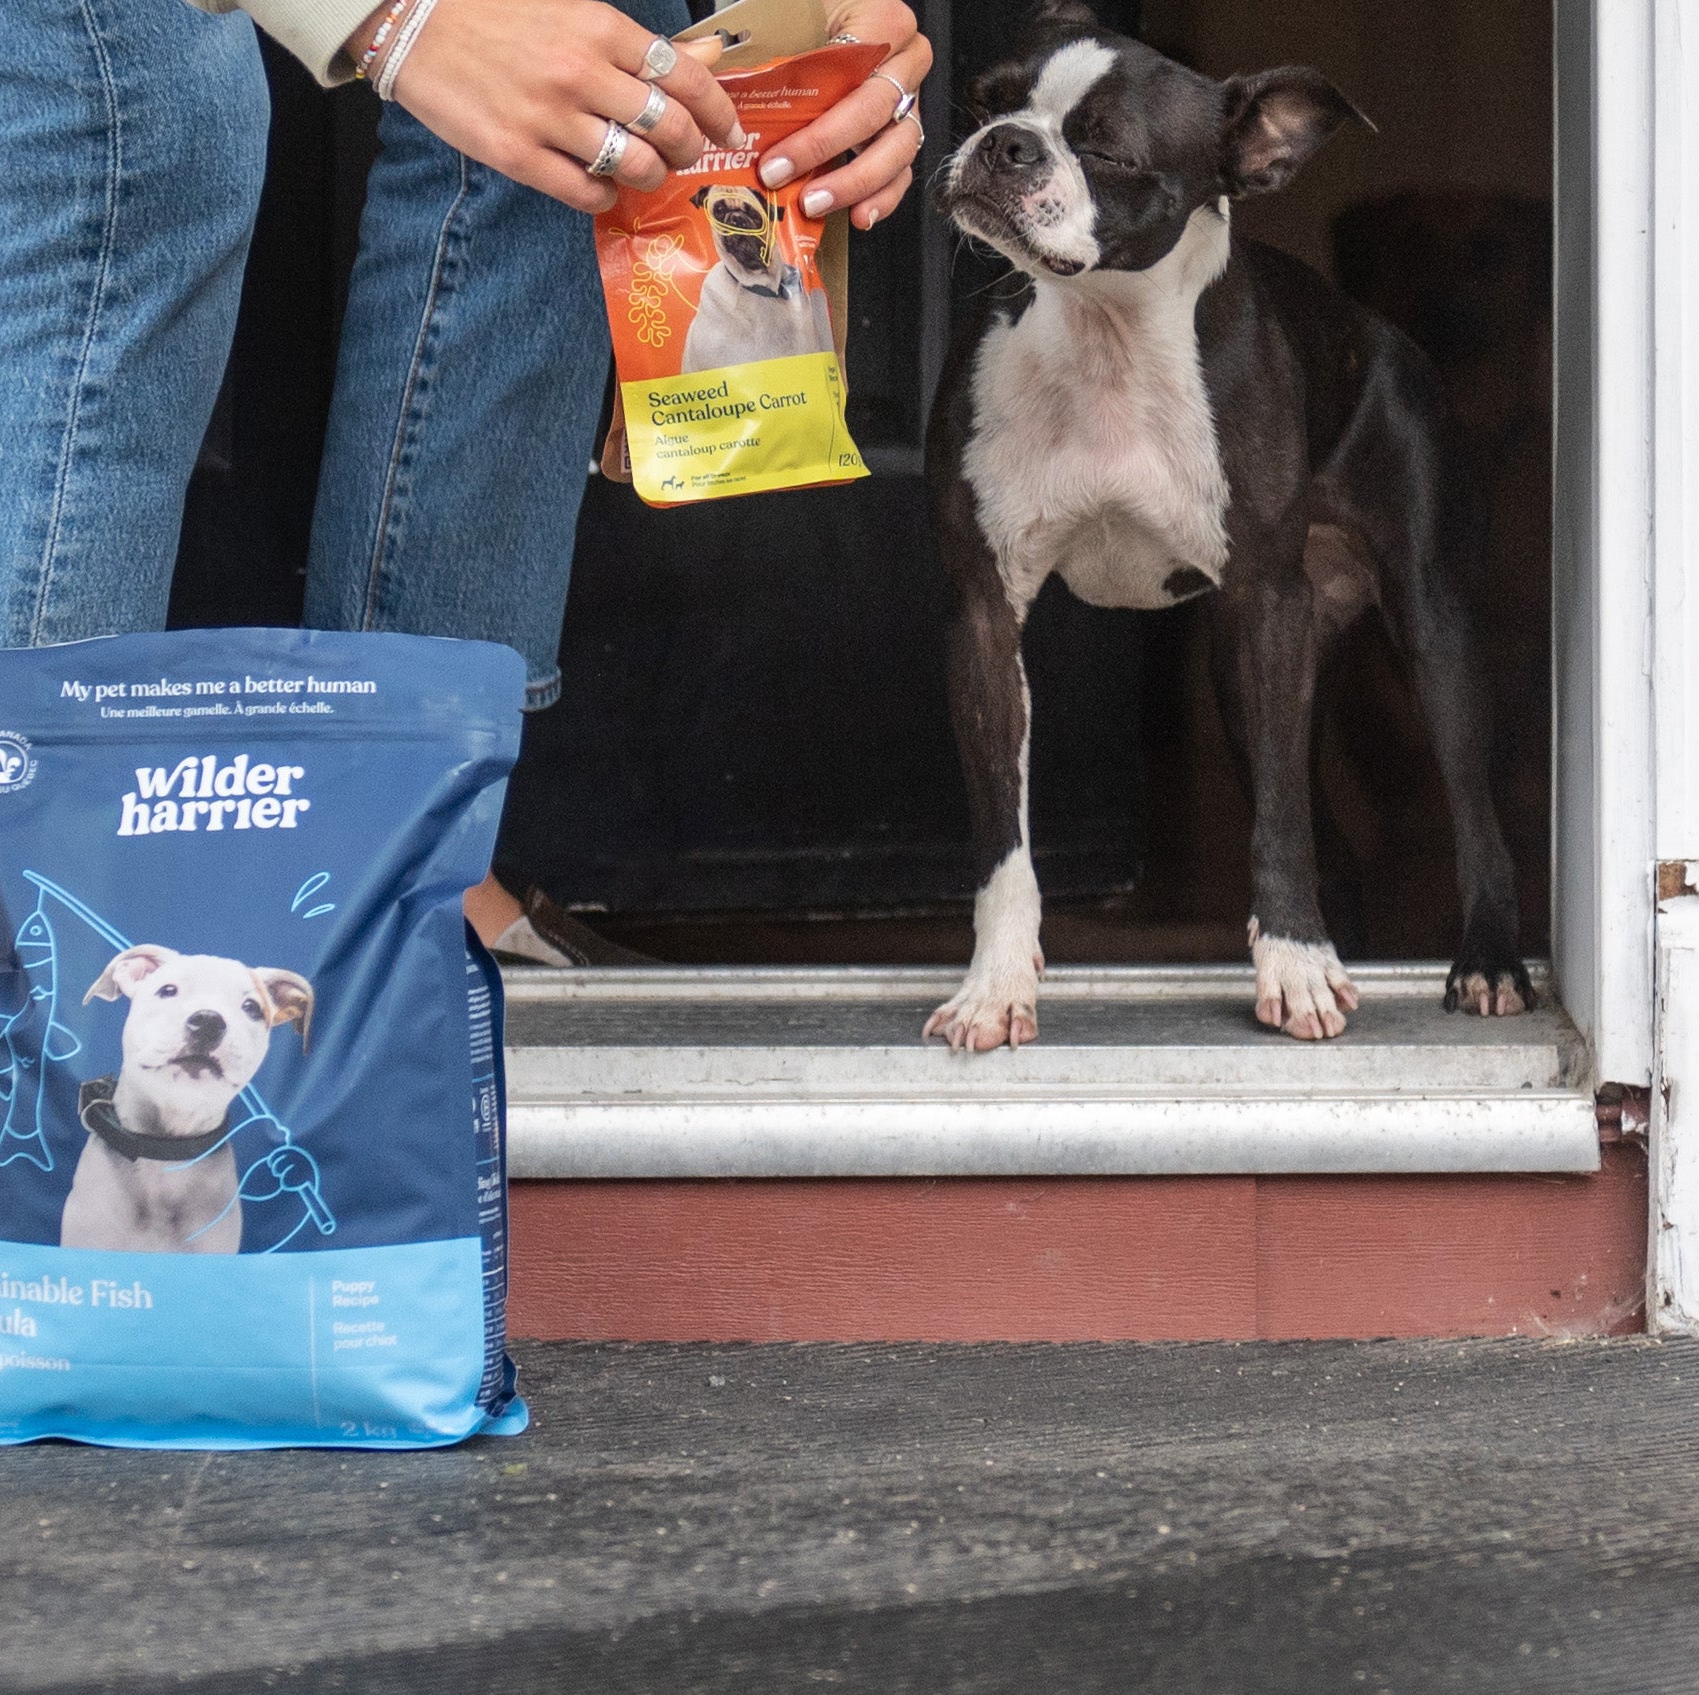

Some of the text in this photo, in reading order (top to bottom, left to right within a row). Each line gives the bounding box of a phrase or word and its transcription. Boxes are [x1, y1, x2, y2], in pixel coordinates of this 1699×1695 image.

[780, 85, 819, 98] human
[648, 380, 729, 408] Seaweed
[651, 400, 757, 426] Cantaloupe
[759, 391, 808, 410] Carrot
[655, 434, 690, 447] Algue
[656, 437, 761, 460] cantaloup carotte
[60, 675, 377, 702] My pet makes me a better human
[100, 700, 336, 718] Une meilleure gamelle. À grande échelle.
[135, 754, 305, 799] wilder
[117, 791, 311, 836] harrier
[91, 1279, 153, 1309] Fish
[332, 1279, 376, 1294] Puppy
[332, 1294, 380, 1308] Recipe
[333, 1321, 386, 1335] Recette
[333, 1337, 363, 1352] pour
[340, 1420, 359, 1437] 2
